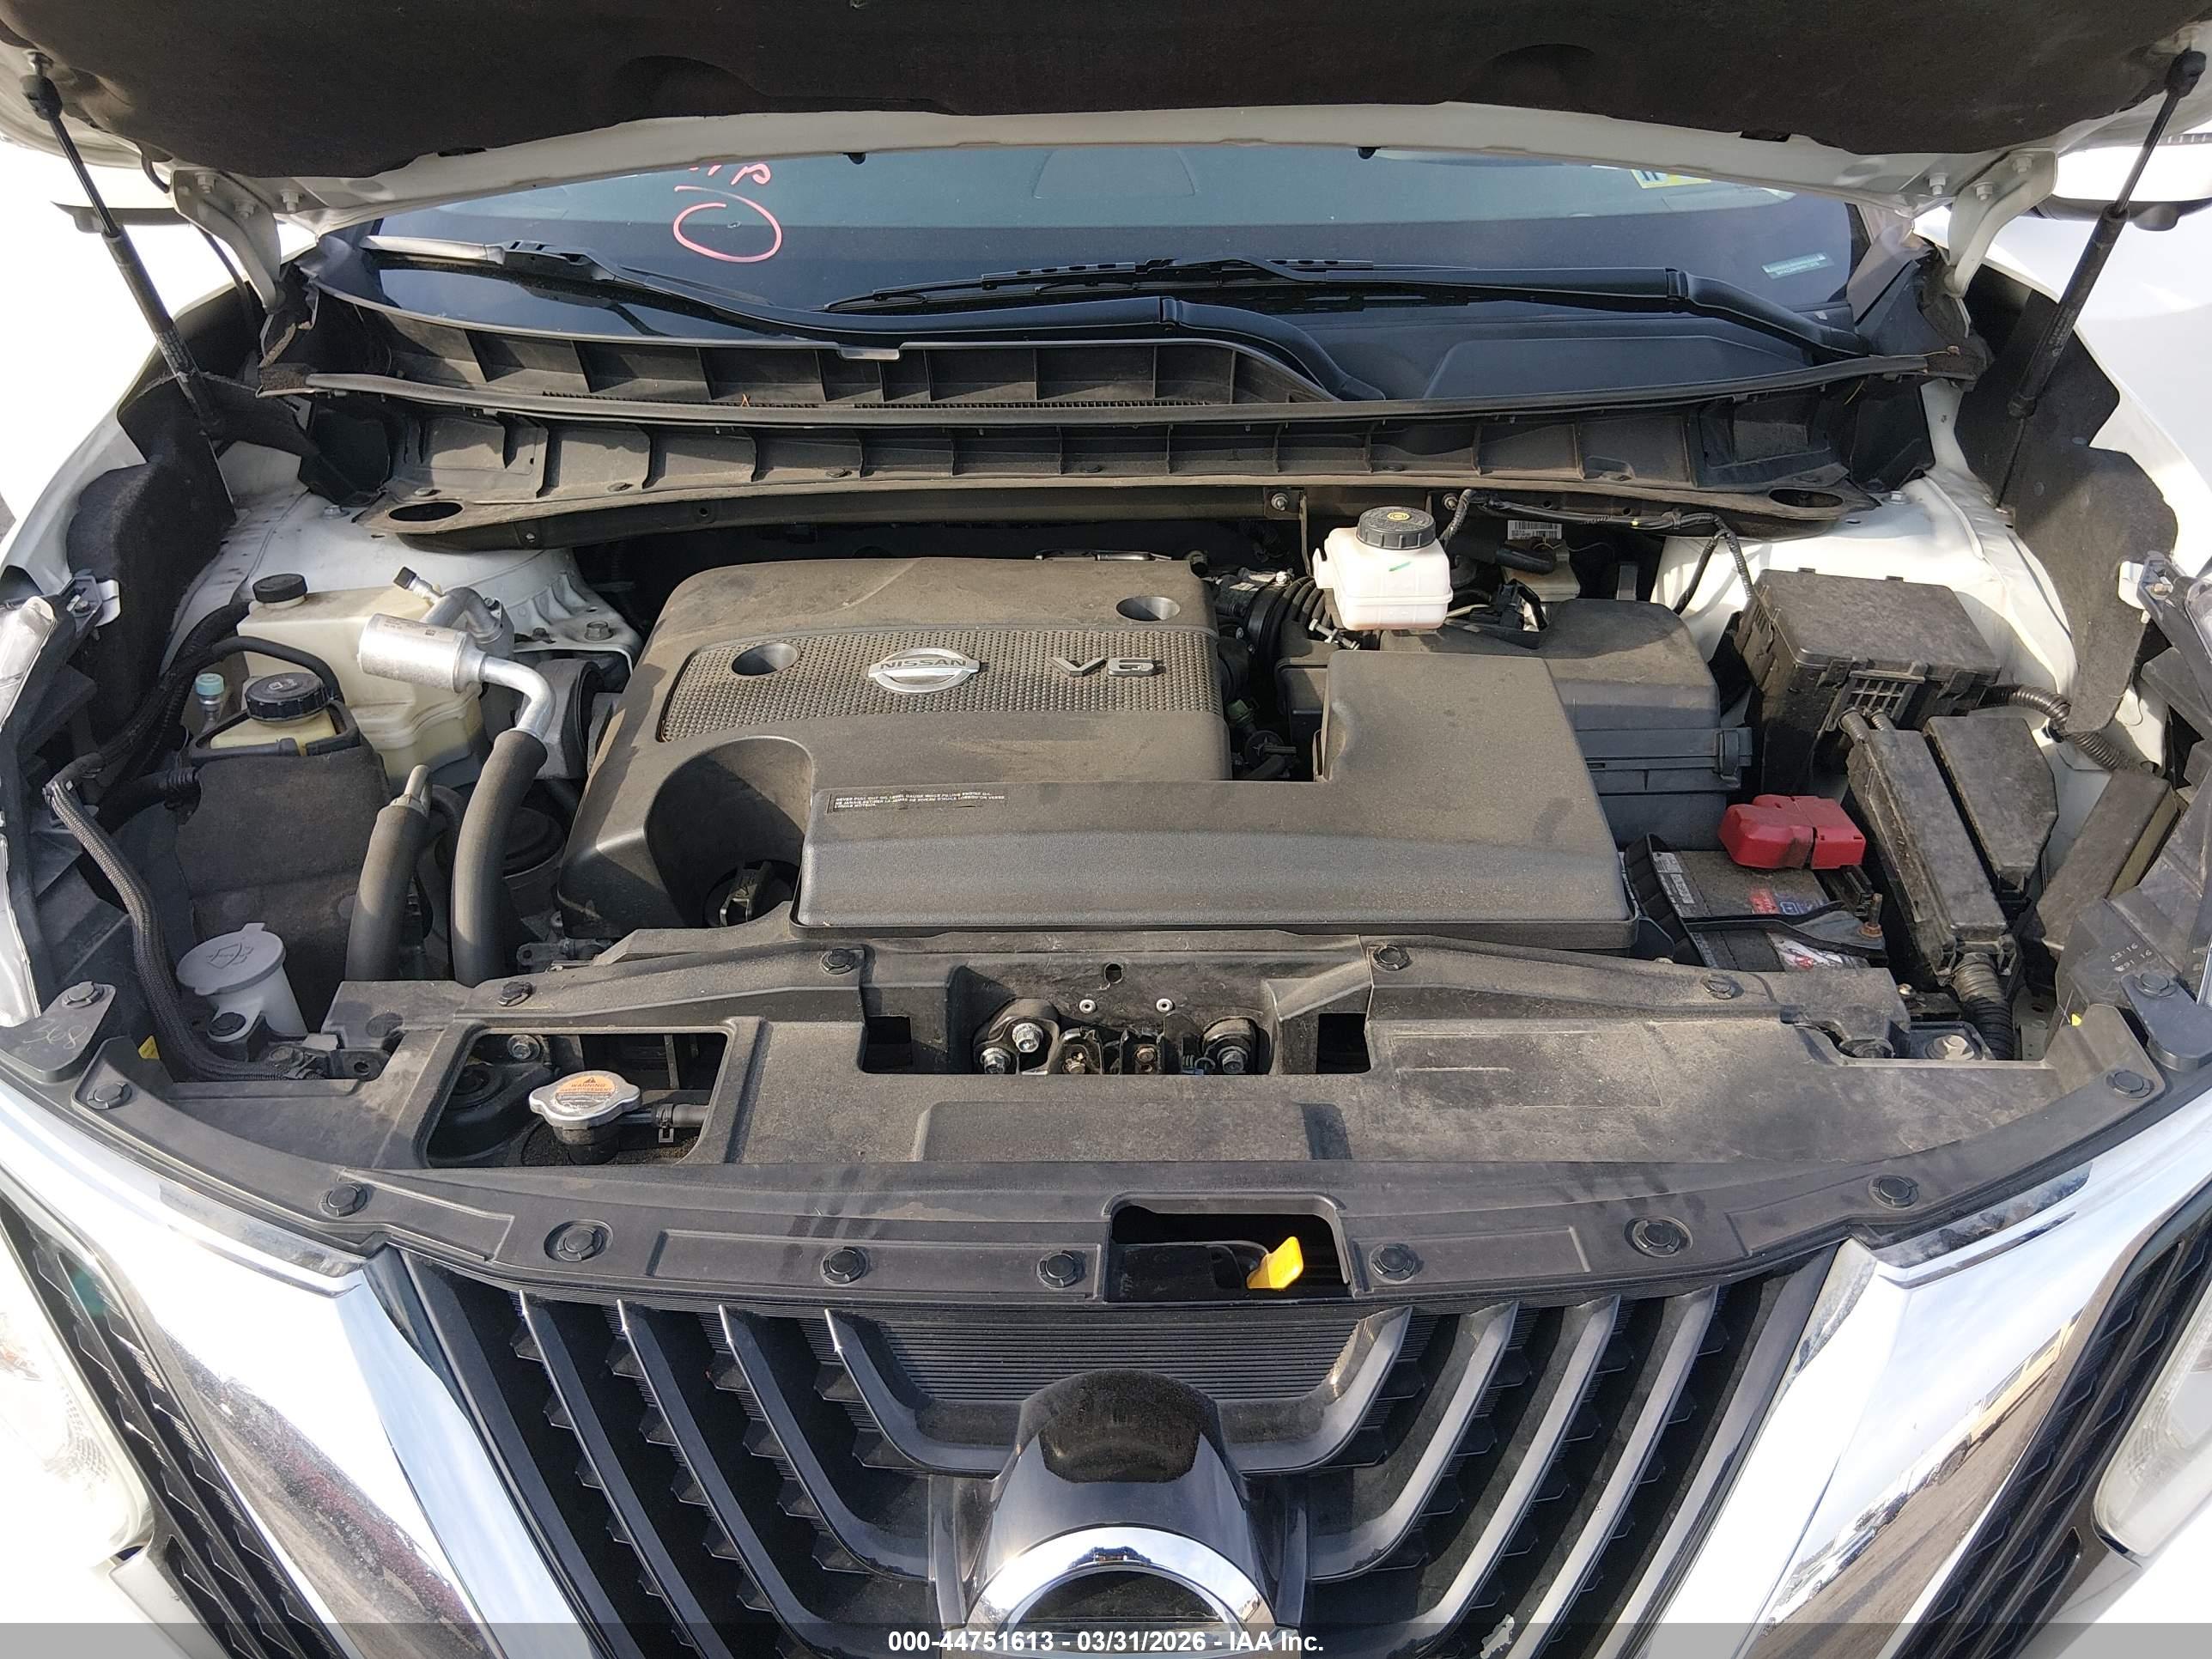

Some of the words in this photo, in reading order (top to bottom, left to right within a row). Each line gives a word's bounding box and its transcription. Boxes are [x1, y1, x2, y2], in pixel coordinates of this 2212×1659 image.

[880, 659, 966, 669] NISSAN
[1045, 656, 1154, 677] V6
[22, 1018, 88, 1050] 368
